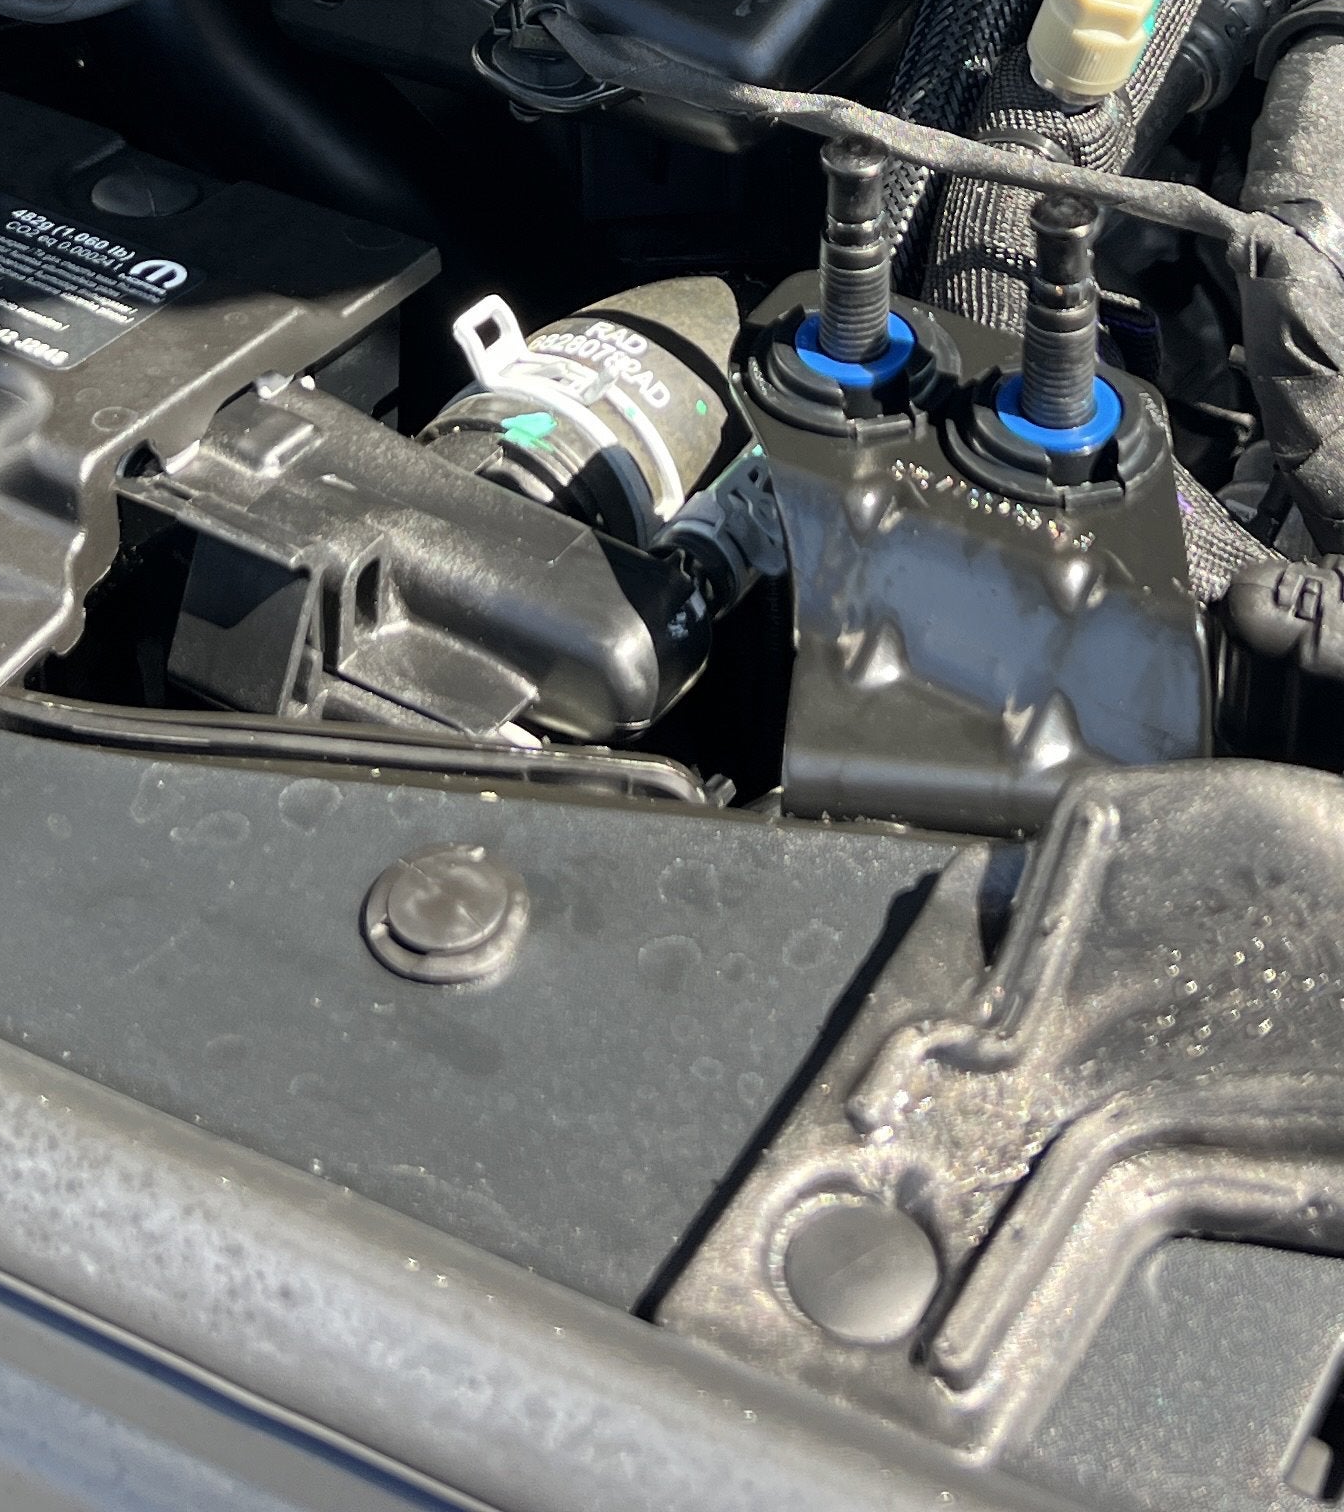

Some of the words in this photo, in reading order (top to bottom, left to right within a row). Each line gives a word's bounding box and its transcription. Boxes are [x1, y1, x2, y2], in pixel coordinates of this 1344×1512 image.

[6, 220, 40, 238] CO2
[37, 235, 58, 248] eq
[11, 209, 55, 232] 482g
[51, 225, 110, 250] (1.060
[107, 245, 136, 262] lb)
[585, 321, 648, 355] RAD
